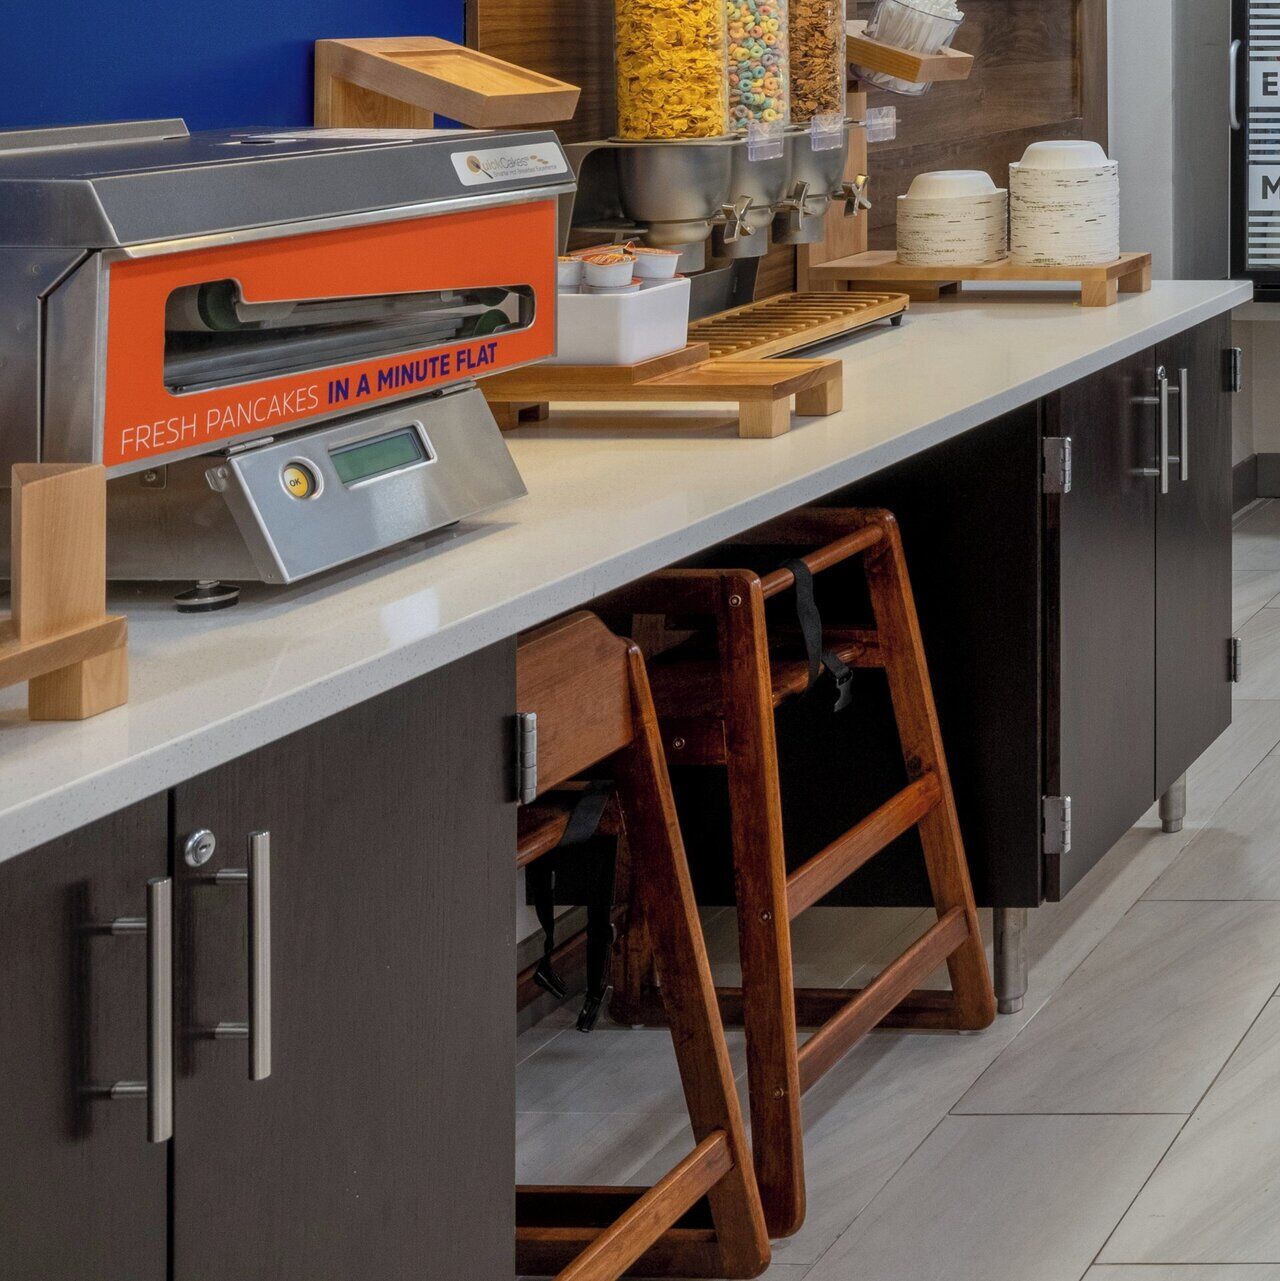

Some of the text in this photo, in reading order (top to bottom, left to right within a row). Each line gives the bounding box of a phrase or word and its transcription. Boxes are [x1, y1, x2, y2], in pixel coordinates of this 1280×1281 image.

[120, 342, 498, 455] FRESH PANCAKES IN A MINUTE FLAT
[289, 477, 301, 487] OK
